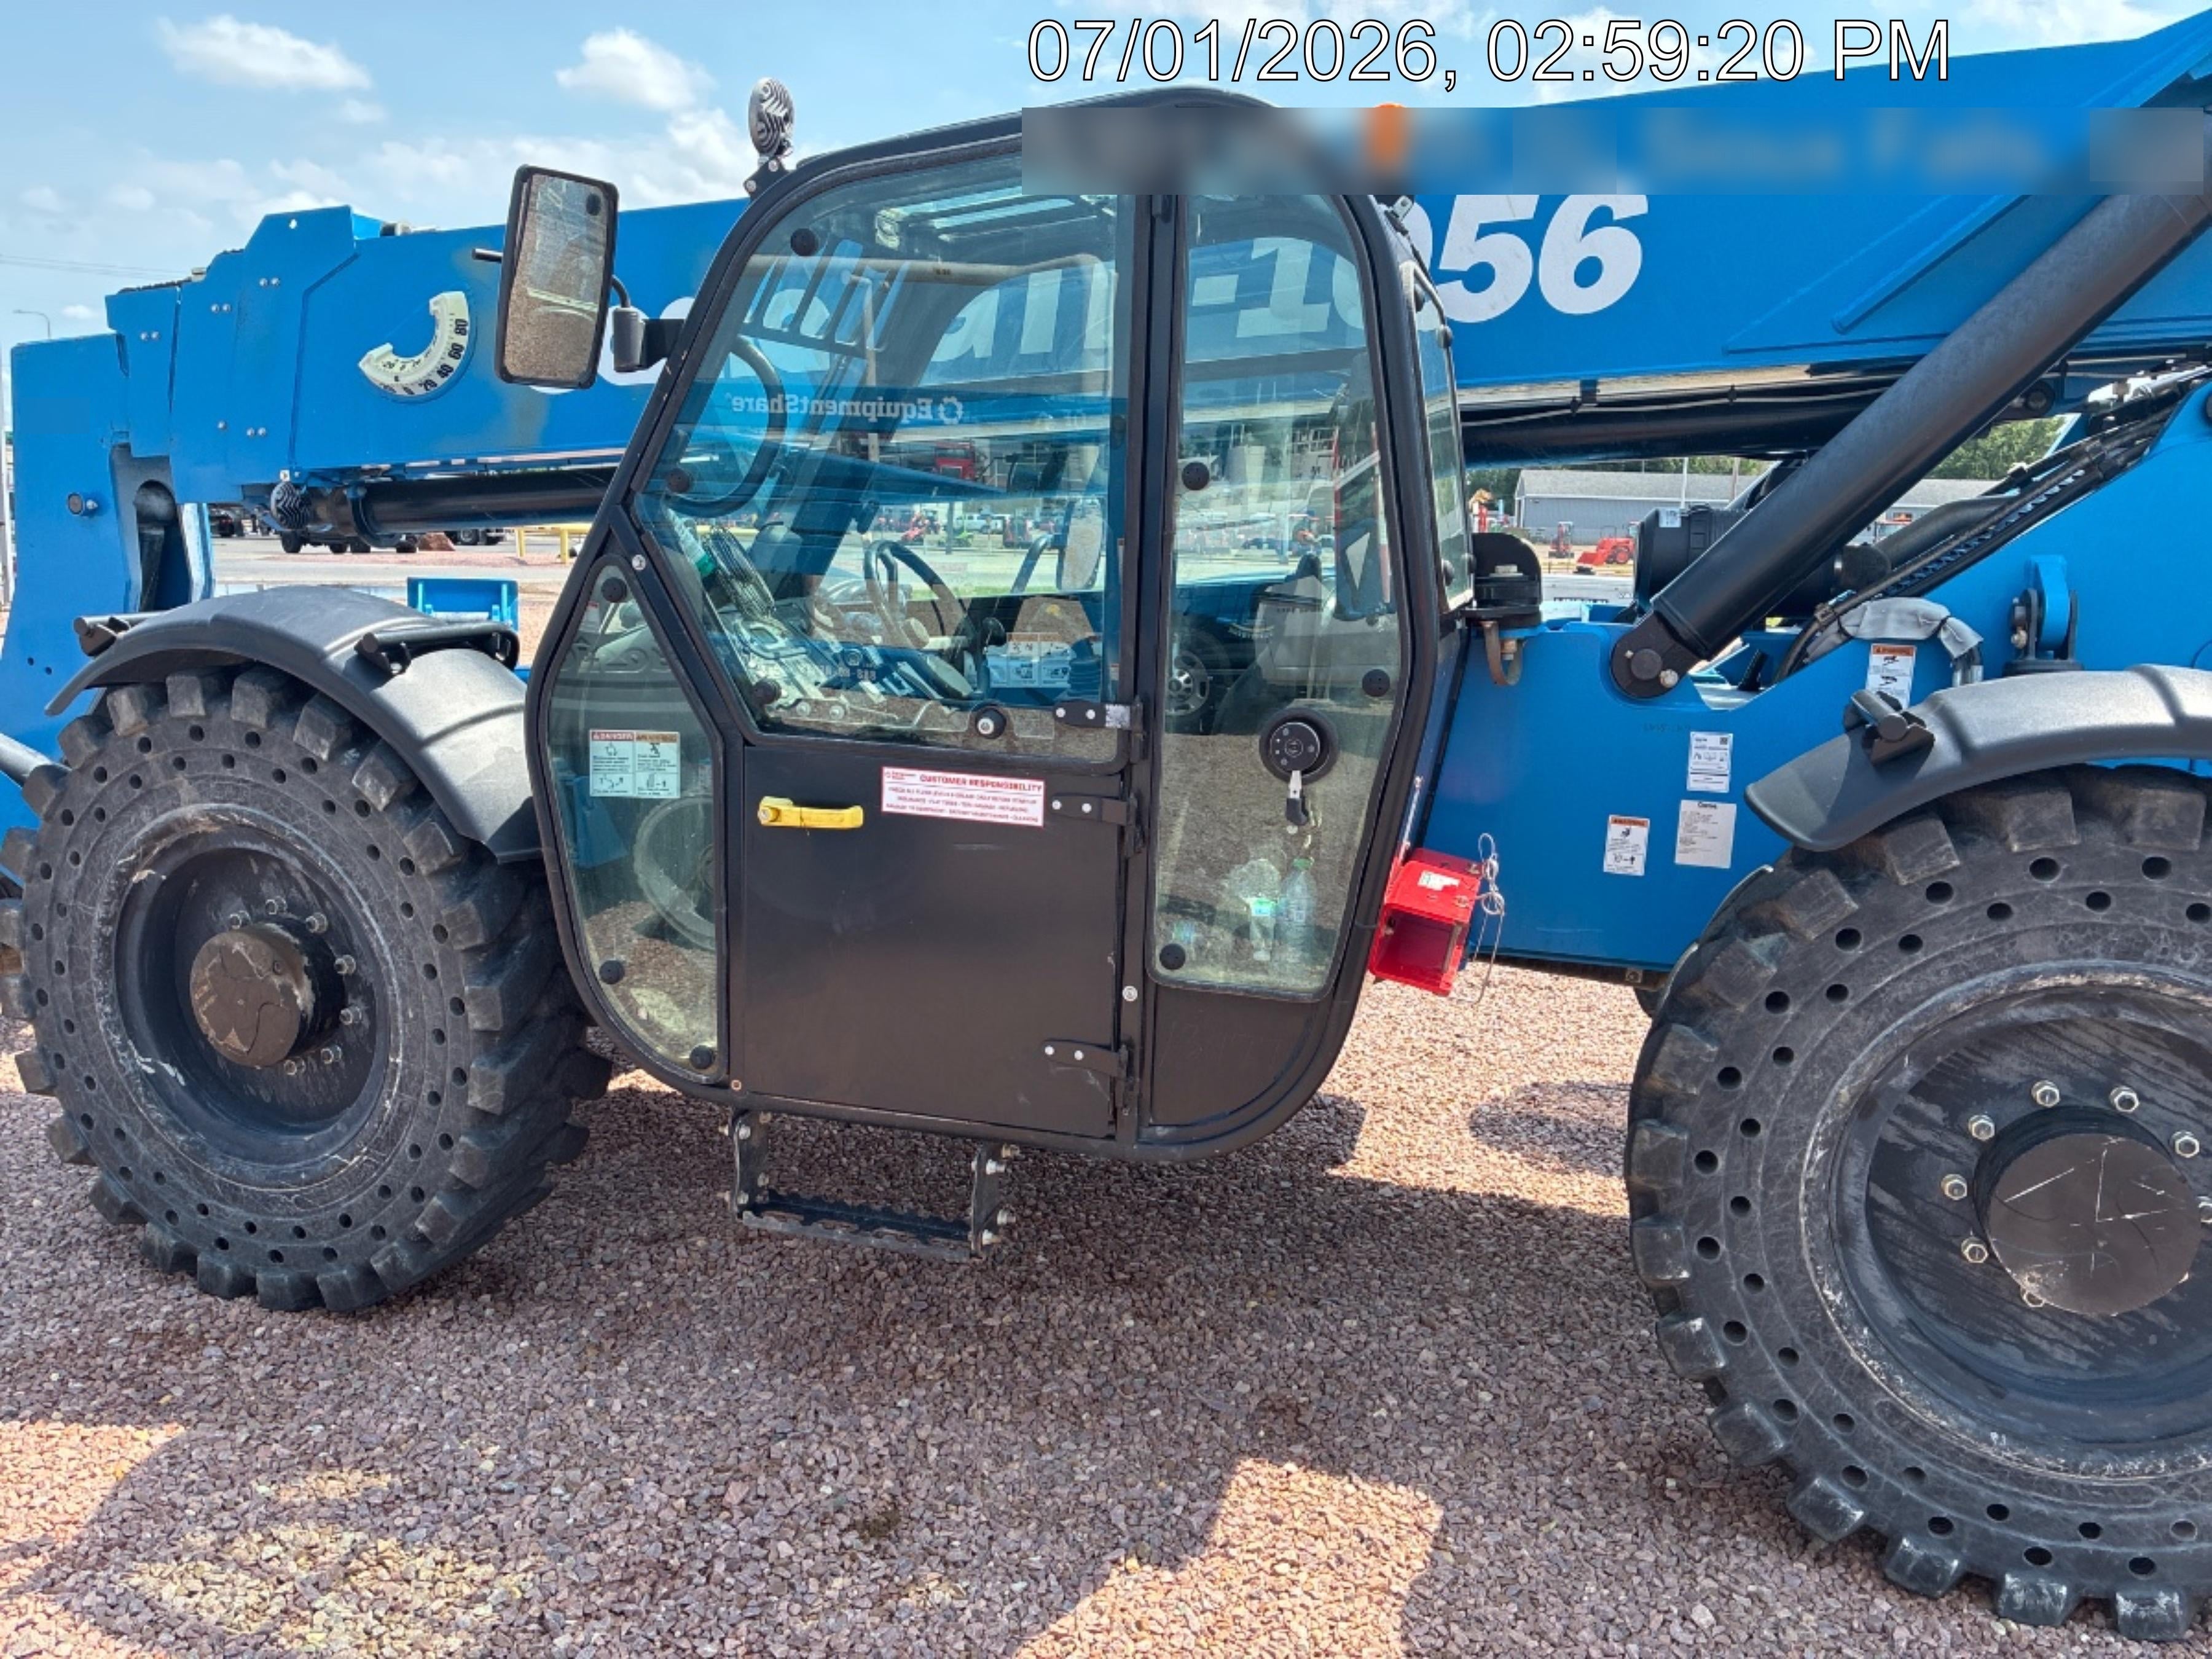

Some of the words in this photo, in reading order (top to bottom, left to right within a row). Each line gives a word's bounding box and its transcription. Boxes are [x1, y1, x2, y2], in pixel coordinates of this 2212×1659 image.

[453, 319, 468, 335] 80
[448, 343, 464, 359] 60
[920, 774, 967, 785] CUSTOMER
[969, 778, 1043, 792] RESPONSIBILITY
